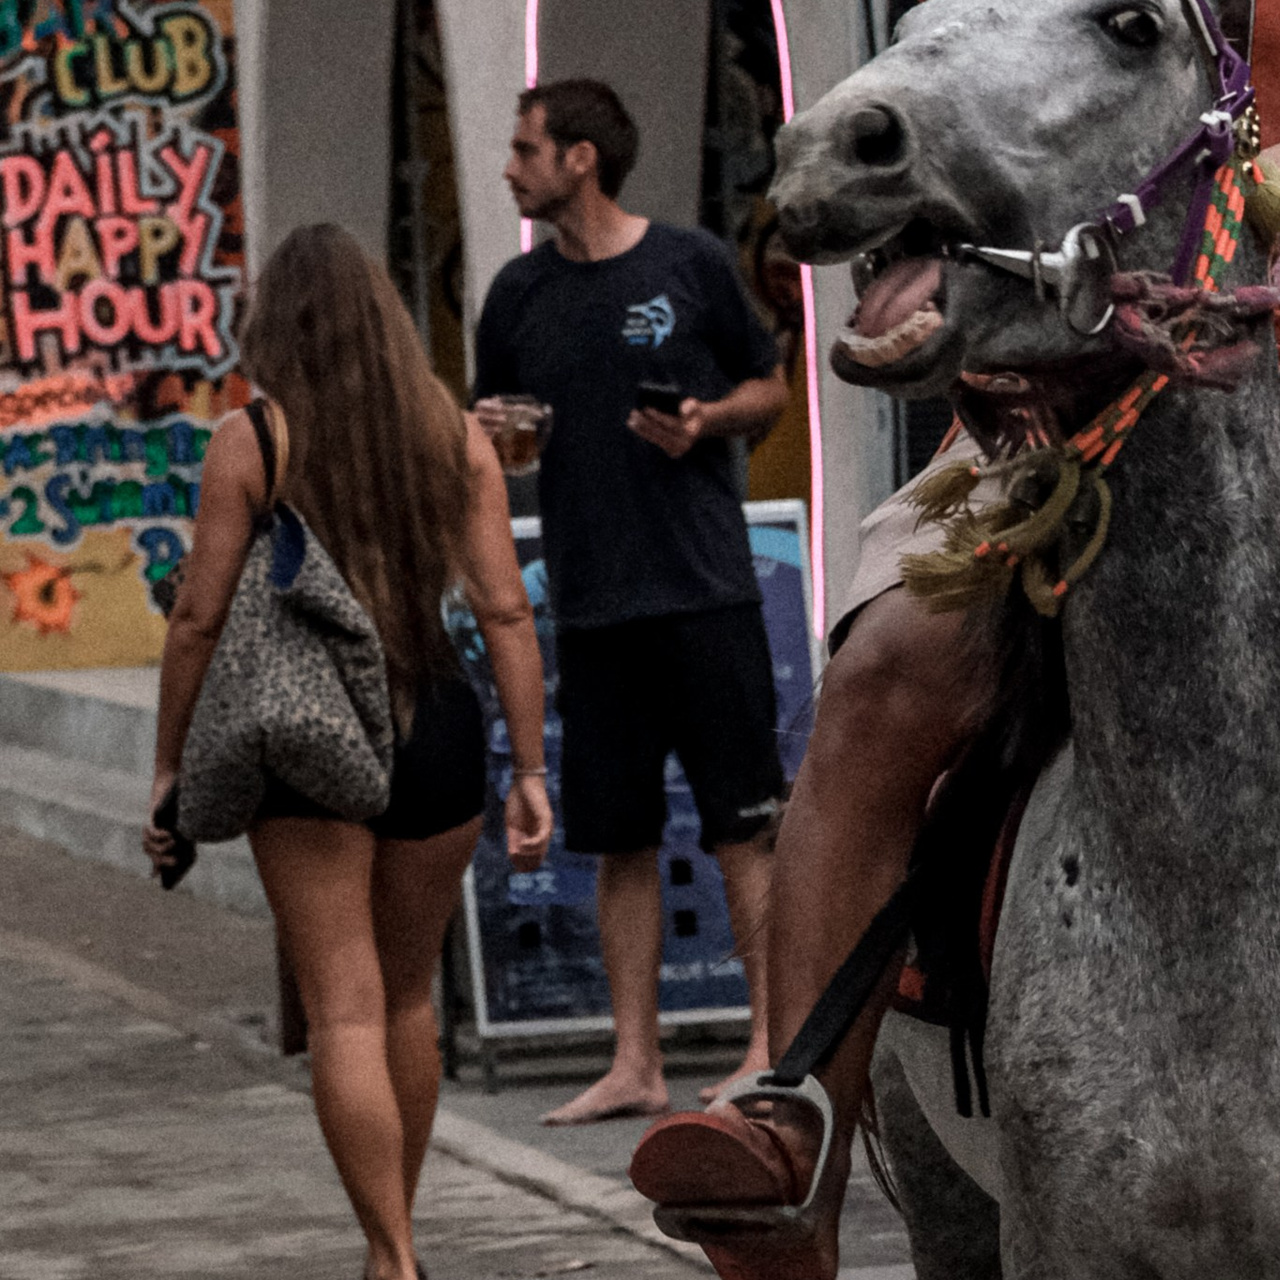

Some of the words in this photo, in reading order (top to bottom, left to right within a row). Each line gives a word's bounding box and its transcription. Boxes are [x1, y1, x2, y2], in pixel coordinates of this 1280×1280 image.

[56, 17, 210, 106] CLUB
[10, 214, 207, 291] HAPPY
[13, 282, 220, 361] HOUR
